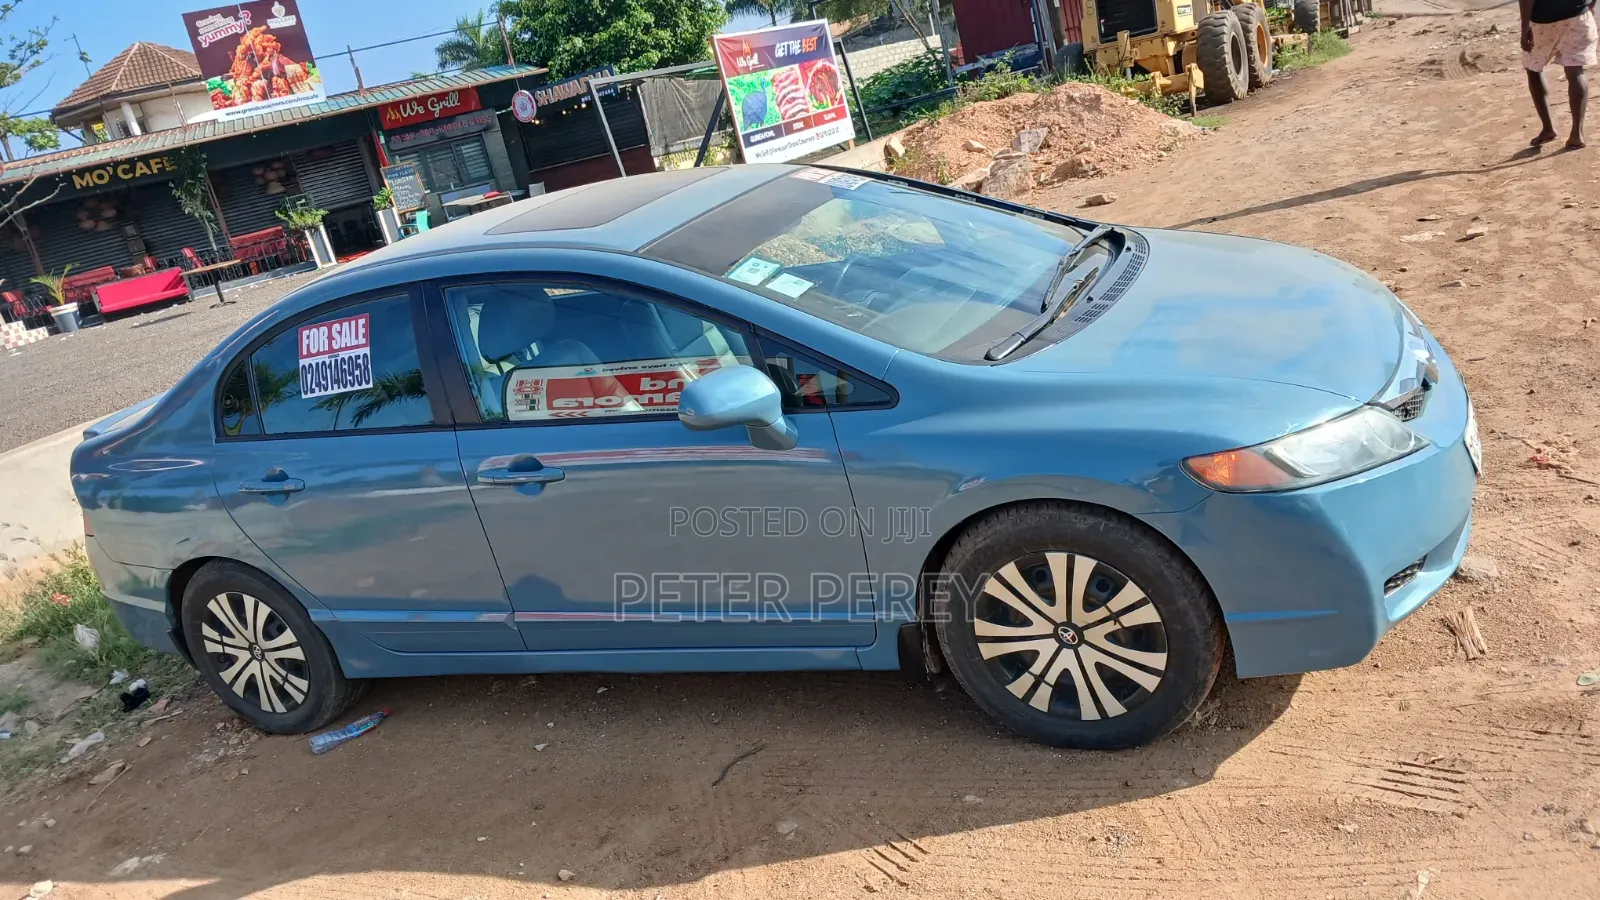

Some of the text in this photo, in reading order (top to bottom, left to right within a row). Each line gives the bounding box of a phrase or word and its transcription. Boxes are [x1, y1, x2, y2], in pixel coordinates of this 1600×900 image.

[775, 36, 818, 58] GET THE BEST
[400, 91, 460, 117] We Grill
[303, 318, 366, 356] FOR SALE
[301, 353, 371, 396] 0249146958
